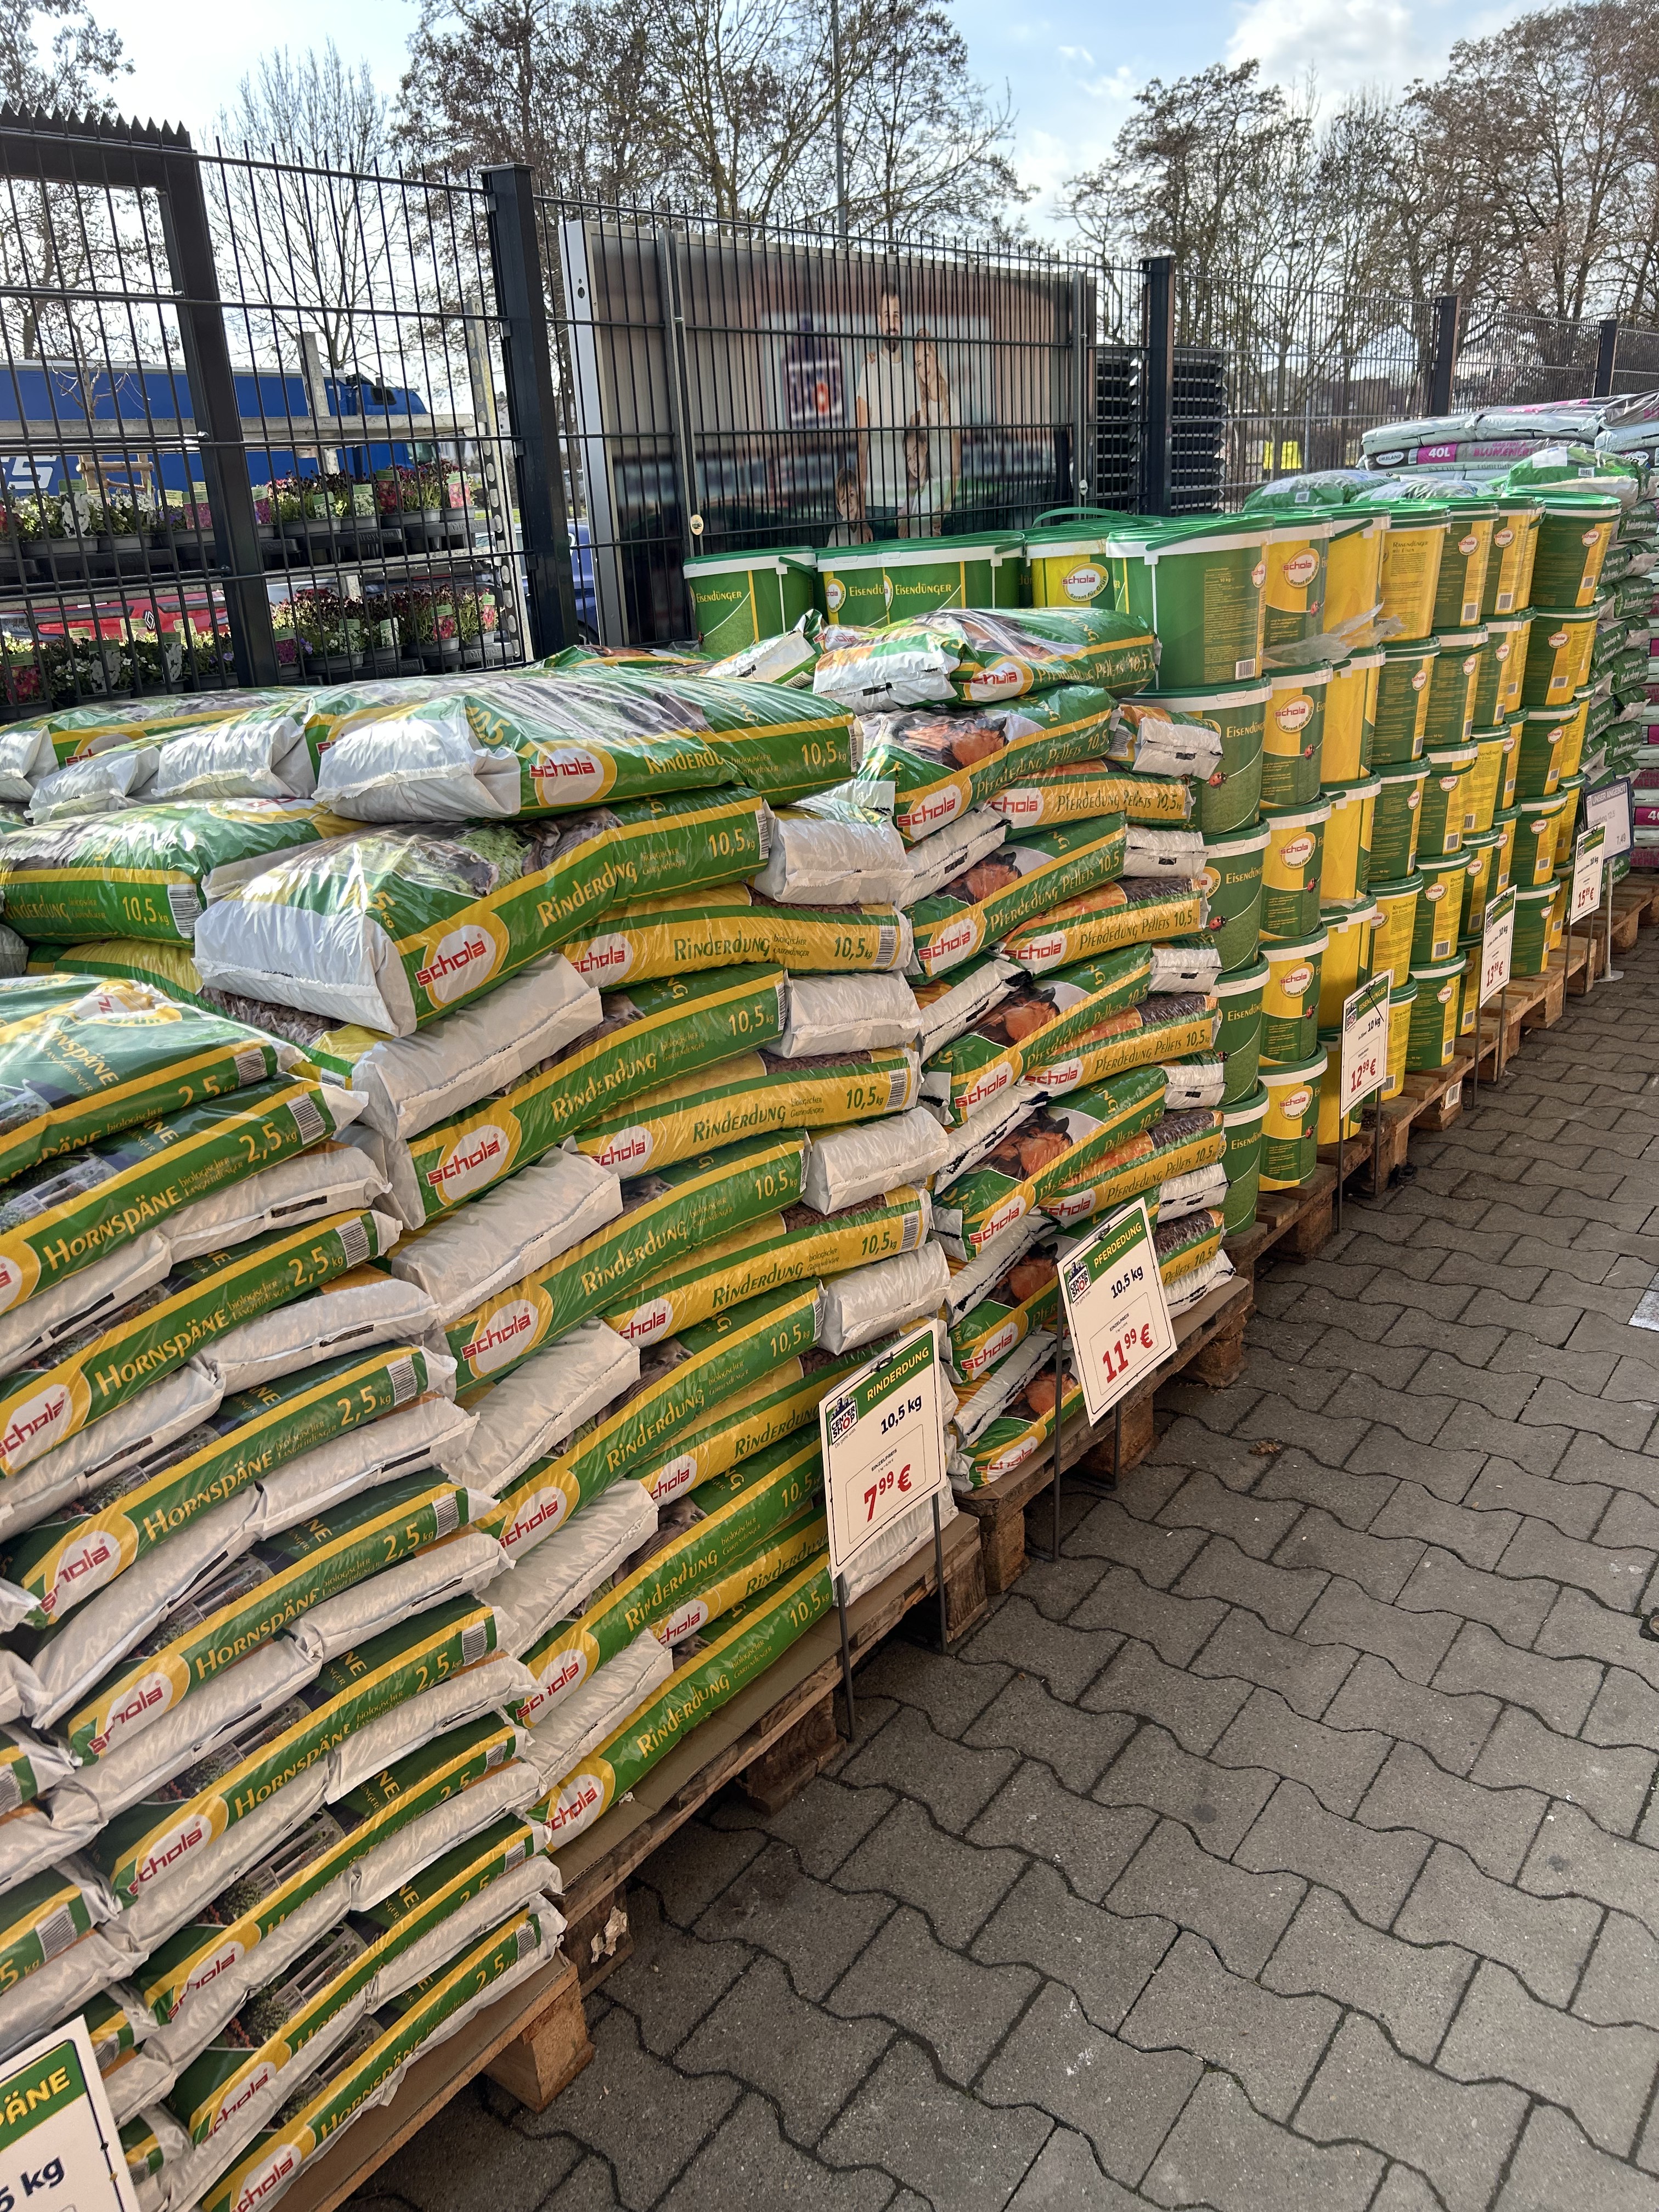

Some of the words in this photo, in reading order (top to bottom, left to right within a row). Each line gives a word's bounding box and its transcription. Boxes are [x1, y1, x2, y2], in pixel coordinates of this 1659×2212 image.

[1428, 447, 1451, 458] 40L
[1062, 575, 1096, 585] schola
[1283, 562, 1312, 571] schola
[1275, 707, 1306, 718] schola
[801, 741, 837, 768] 10,5
[838, 753, 847, 764] kg
[1592, 790, 1607, 805] UNSER
[1606, 785, 1627, 801] ANGEBOT
[897, 797, 956, 828] schola
[1280, 844, 1309, 855] schola
[122, 895, 157, 926] 10,5
[158, 912, 170, 926] kg
[416, 941, 487, 987] schola
[709, 828, 746, 859] 10,5
[746, 838, 755, 851] kg
[918, 931, 970, 961] schola
[1098, 852, 1120, 873] 10,5
[834, 936, 866, 959] 10,5
[865, 949, 873, 960] kg
[1005, 943, 1062, 960] schola
[1174, 910, 1193, 928] 10,5
[1280, 973, 1308, 984] schola
[1187, 1028, 1205, 1047] 10,5
[1368, 1020, 1374, 1032] 10
[1374, 1017, 1381, 1029] kg
[1370, 1058, 1376, 1076] €
[427, 1137, 501, 1187] schola
[728, 1005, 764, 1037] 10,5
[765, 1014, 774, 1026] kg
[847, 1086, 877, 1109] 10,5
[876, 1094, 884, 1107] kg
[955, 1072, 1008, 1109] schola
[1280, 1096, 1306, 1107] schola
[239, 1122, 283, 1164] 2,5
[286, 1132, 297, 1144] kg
[1195, 1145, 1213, 1165] 10,5
[969, 1206, 1019, 1245] schola
[1094, 1222, 1142, 1268] PFERDEDUNG
[289, 1246, 329, 1287] 2,5
[332, 1256, 343, 1268] kg
[462, 1311, 531, 1361] schola
[755, 1168, 788, 1200] 10,5
[789, 1177, 798, 1190] kg
[616, 1312, 666, 1341] chola
[861, 1230, 890, 1256] 10,5
[889, 1239, 897, 1251] kg
[1070, 1271, 1087, 1291] CENTER
[1071, 1277, 1089, 1299] SHOP
[1111, 1272, 1130, 1299] 10,5
[1132, 1265, 1144, 1282] kg
[770, 1323, 802, 1358] 10,5
[803, 1330, 810, 1340] kg
[1141, 1323, 1153, 1348] €
[961, 1334, 1013, 1370] schola
[866, 1346, 929, 1401] RINDERDUNG
[337, 1385, 377, 1428] 2,5
[380, 1394, 391, 1406] kg
[831, 1406, 855, 1431] CENTER
[881, 1408, 905, 1435] 10,5
[907, 1395, 922, 1414] kg
[833, 1415, 856, 1439] SHOP
[871, 1448, 898, 1472] EINZELPREIS
[781, 1472, 813, 1509] 10,5
[898, 1464, 912, 1493] €
[383, 1522, 420, 1562] 2,5
[423, 1531, 433, 1543] kg
[790, 1590, 822, 1628] 10,5
[822, 1593, 830, 1604] kg
[415, 1651, 449, 1692] 2,5
[20, 2155, 65, 2197] kg
